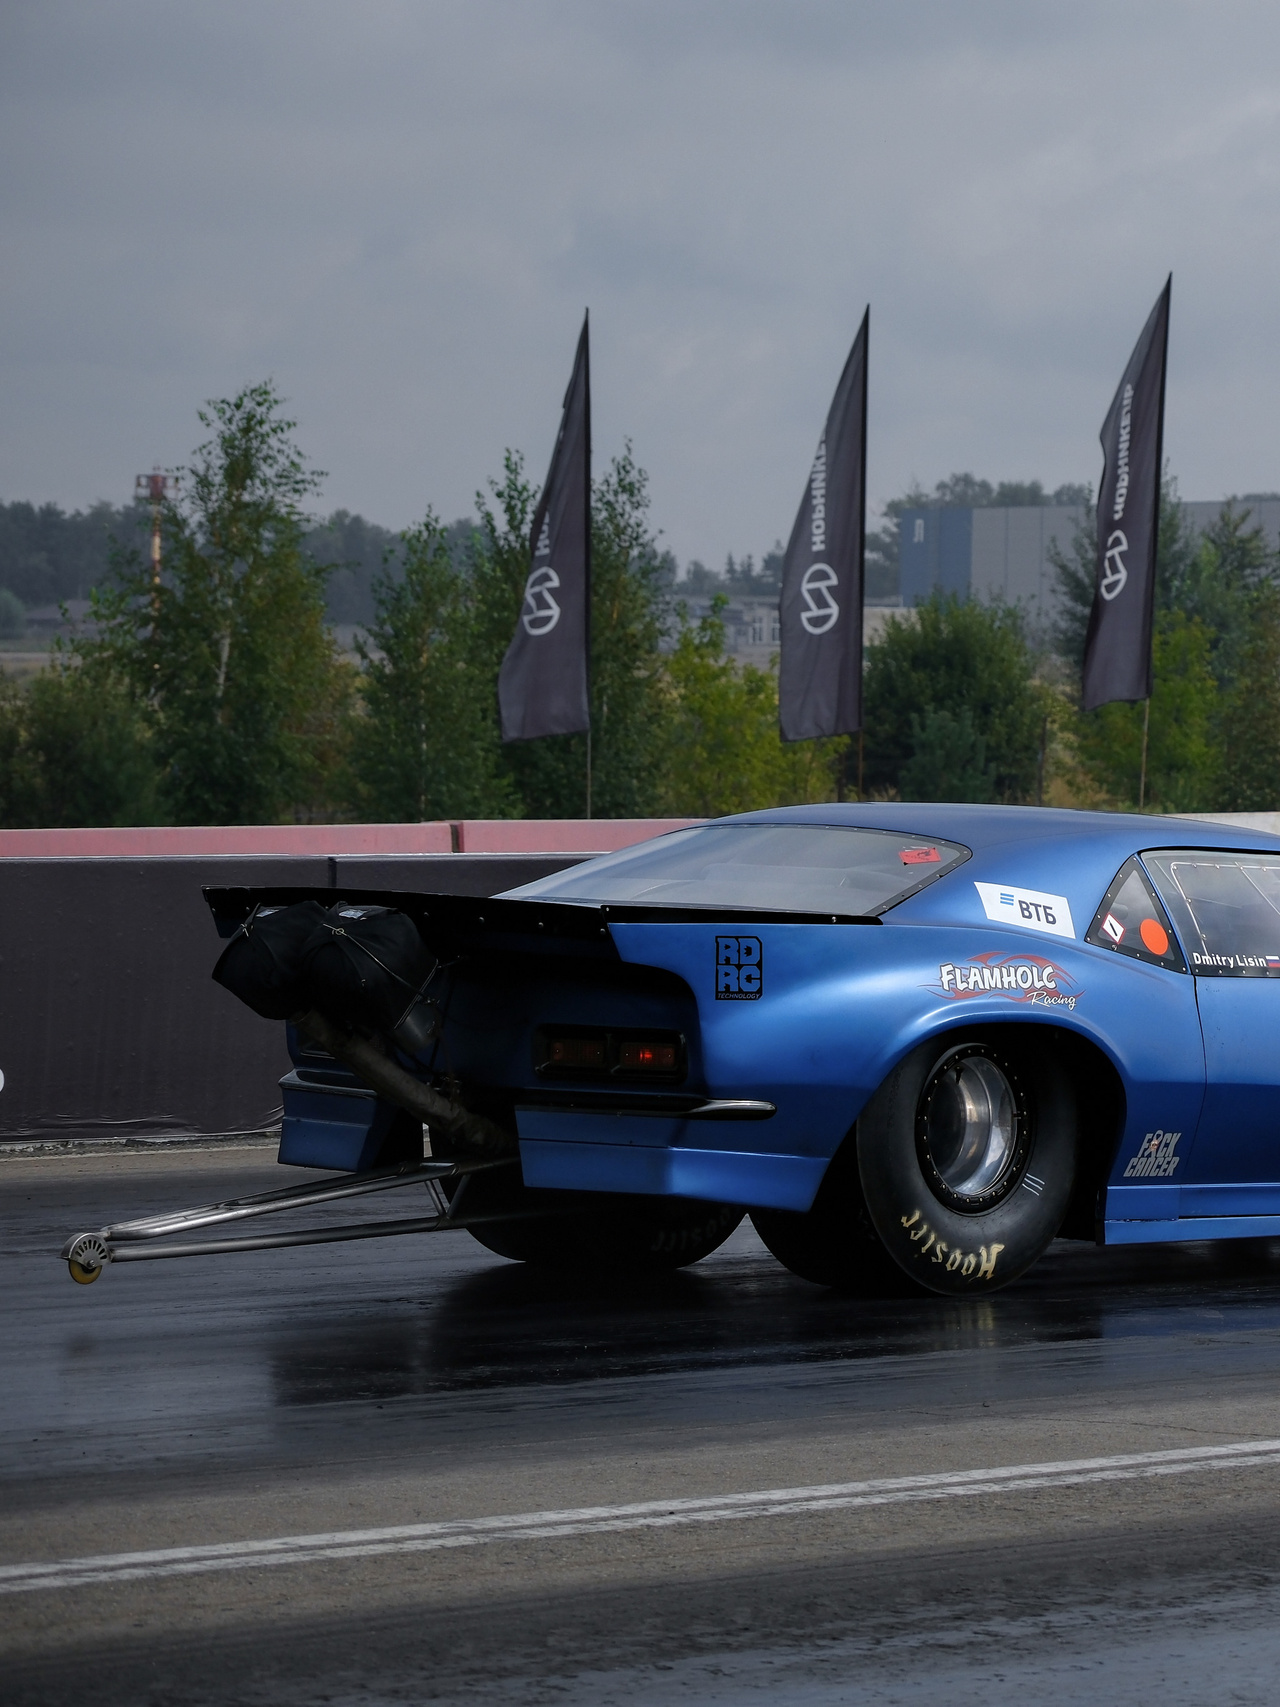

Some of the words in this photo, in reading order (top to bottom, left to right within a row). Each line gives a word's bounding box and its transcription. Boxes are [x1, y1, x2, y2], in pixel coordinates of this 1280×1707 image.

[1018, 900, 1057, 925] ВТБ
[1193, 952, 1234, 968] Dmitry
[1235, 954, 1267, 967] Lisin
[940, 963, 1058, 992] FLAMHOLC
[1027, 990, 1077, 1010] Racing
[1137, 1130, 1182, 1158] FCK
[1123, 1156, 1180, 1177] CANCER
